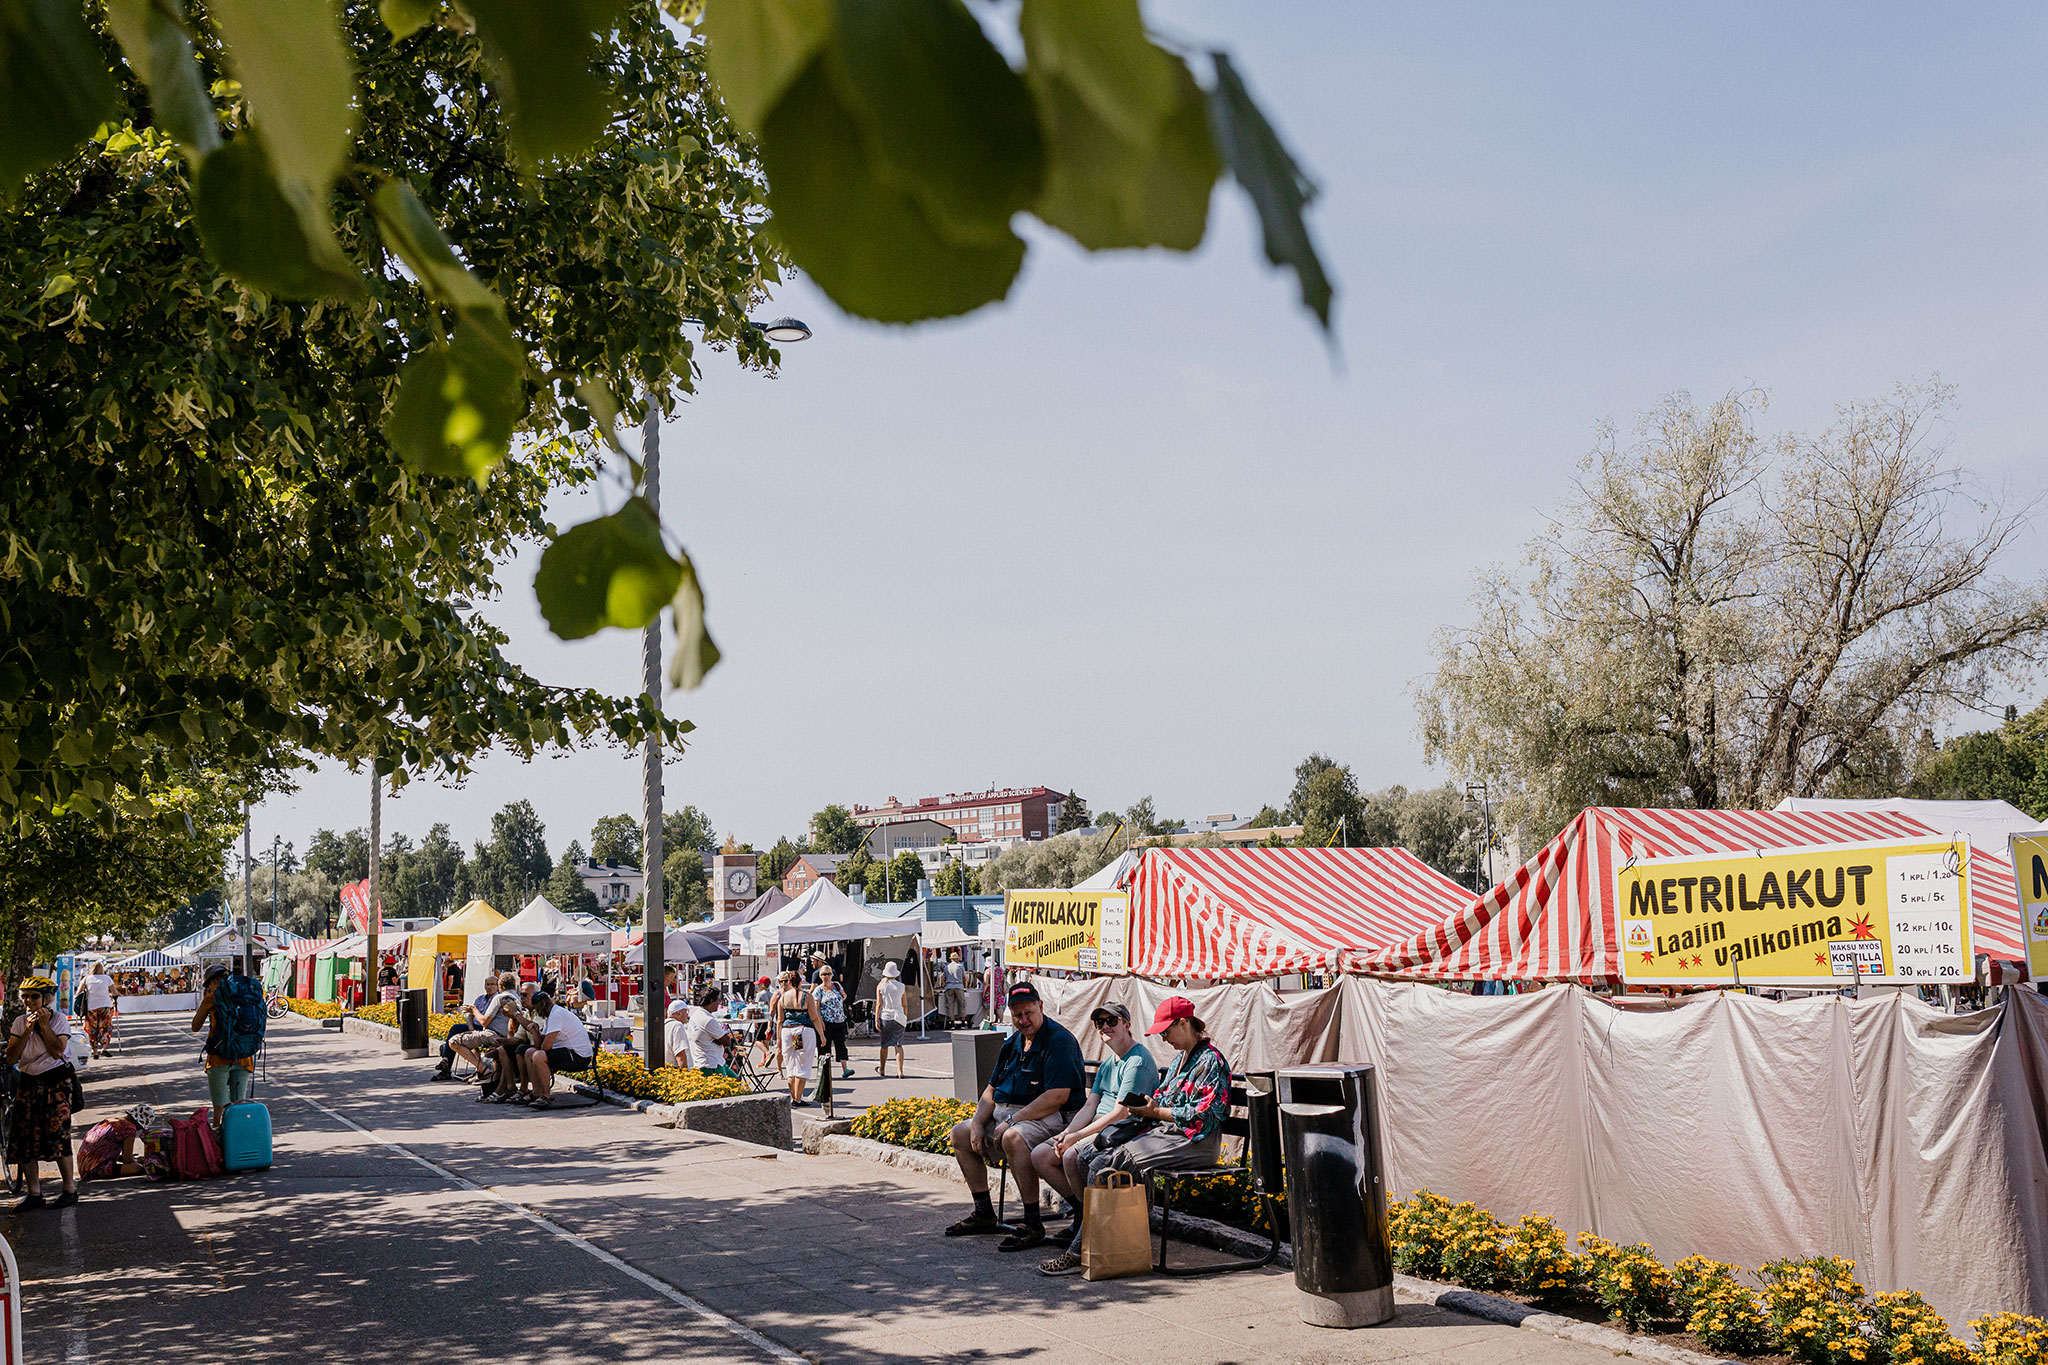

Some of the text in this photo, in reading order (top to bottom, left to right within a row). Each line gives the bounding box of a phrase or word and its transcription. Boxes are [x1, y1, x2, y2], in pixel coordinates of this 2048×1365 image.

[951, 792, 979, 803] UNIVERSITY
[987, 791, 1008, 799] APPLIED
[1008, 788, 1033, 797] SCIENCES
[1900, 872, 1905, 881] 1
[1630, 865, 1873, 916] METRILAKUT
[1900, 894, 1907, 903] 5
[1933, 892, 1945, 901] 5€
[1011, 901, 1098, 926] METRILAKUT
[1896, 922, 1909, 932] 12
[1934, 921, 1953, 931] 10€
[1018, 929, 1044, 950] Laajin
[1038, 931, 1085, 958] valikoima
[1657, 920, 1726, 956] Laajin
[1715, 916, 1842, 967] valikoima
[1897, 945, 1911, 954] 20
[1936, 944, 1954, 954] 15€
[1899, 966, 1913, 976] 30
[1939, 966, 1960, 976] 20€
